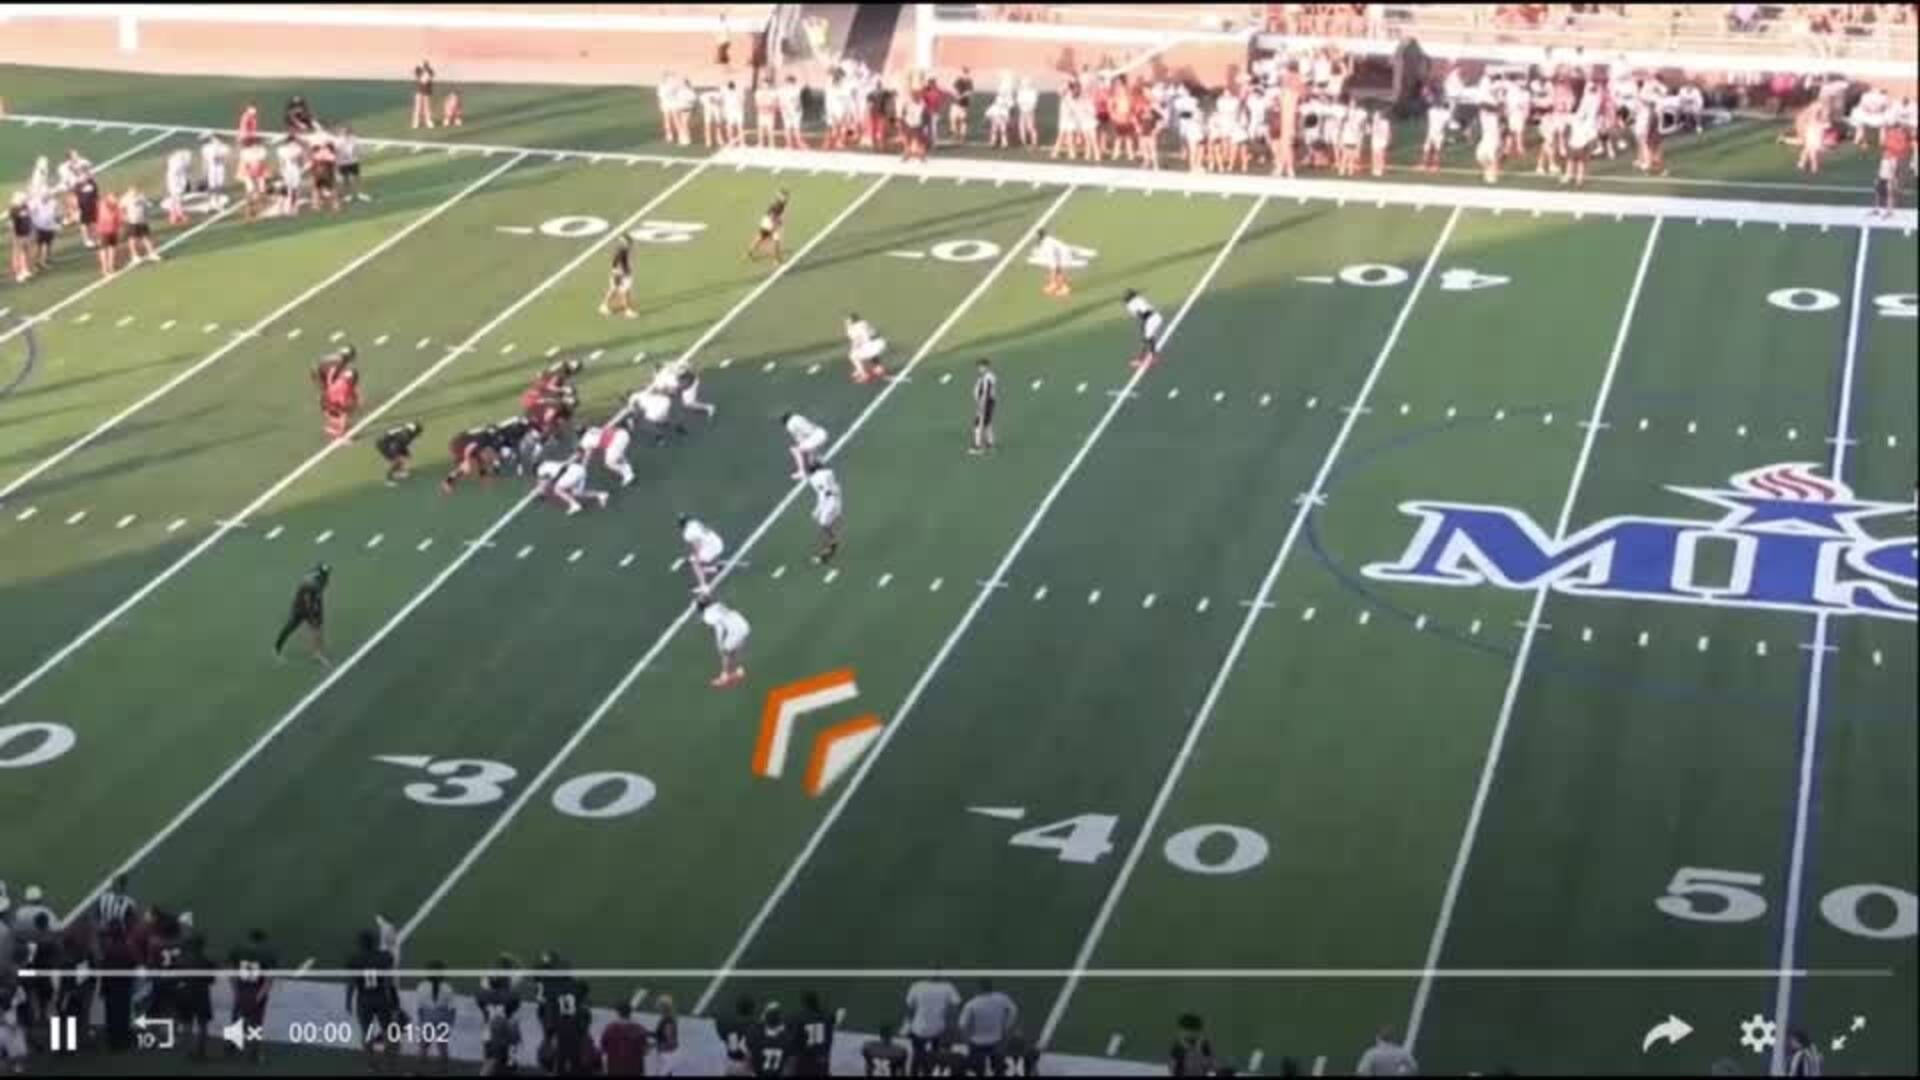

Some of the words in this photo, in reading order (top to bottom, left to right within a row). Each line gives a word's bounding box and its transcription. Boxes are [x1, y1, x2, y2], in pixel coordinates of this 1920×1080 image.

[403, 758, 657, 819] 30
[1008, 813, 1269, 874] 40
[1654, 866, 1919, 939] 50
